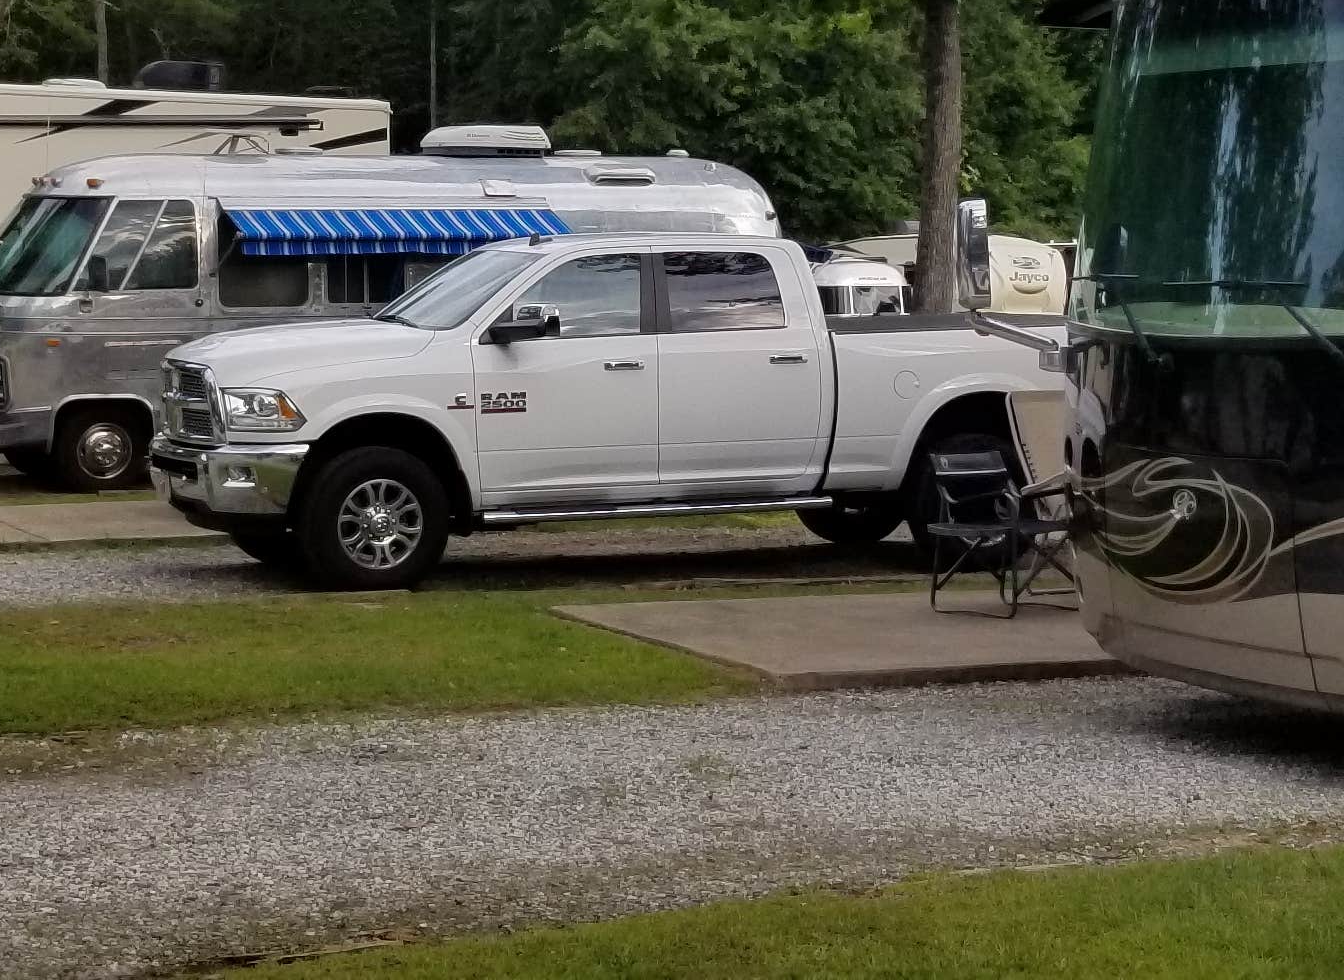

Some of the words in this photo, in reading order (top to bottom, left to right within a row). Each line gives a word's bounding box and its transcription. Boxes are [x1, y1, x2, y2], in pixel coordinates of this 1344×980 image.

[1009, 271, 1049, 283] Jayco
[481, 392, 526, 400] RAM
[481, 400, 526, 408] 2500
